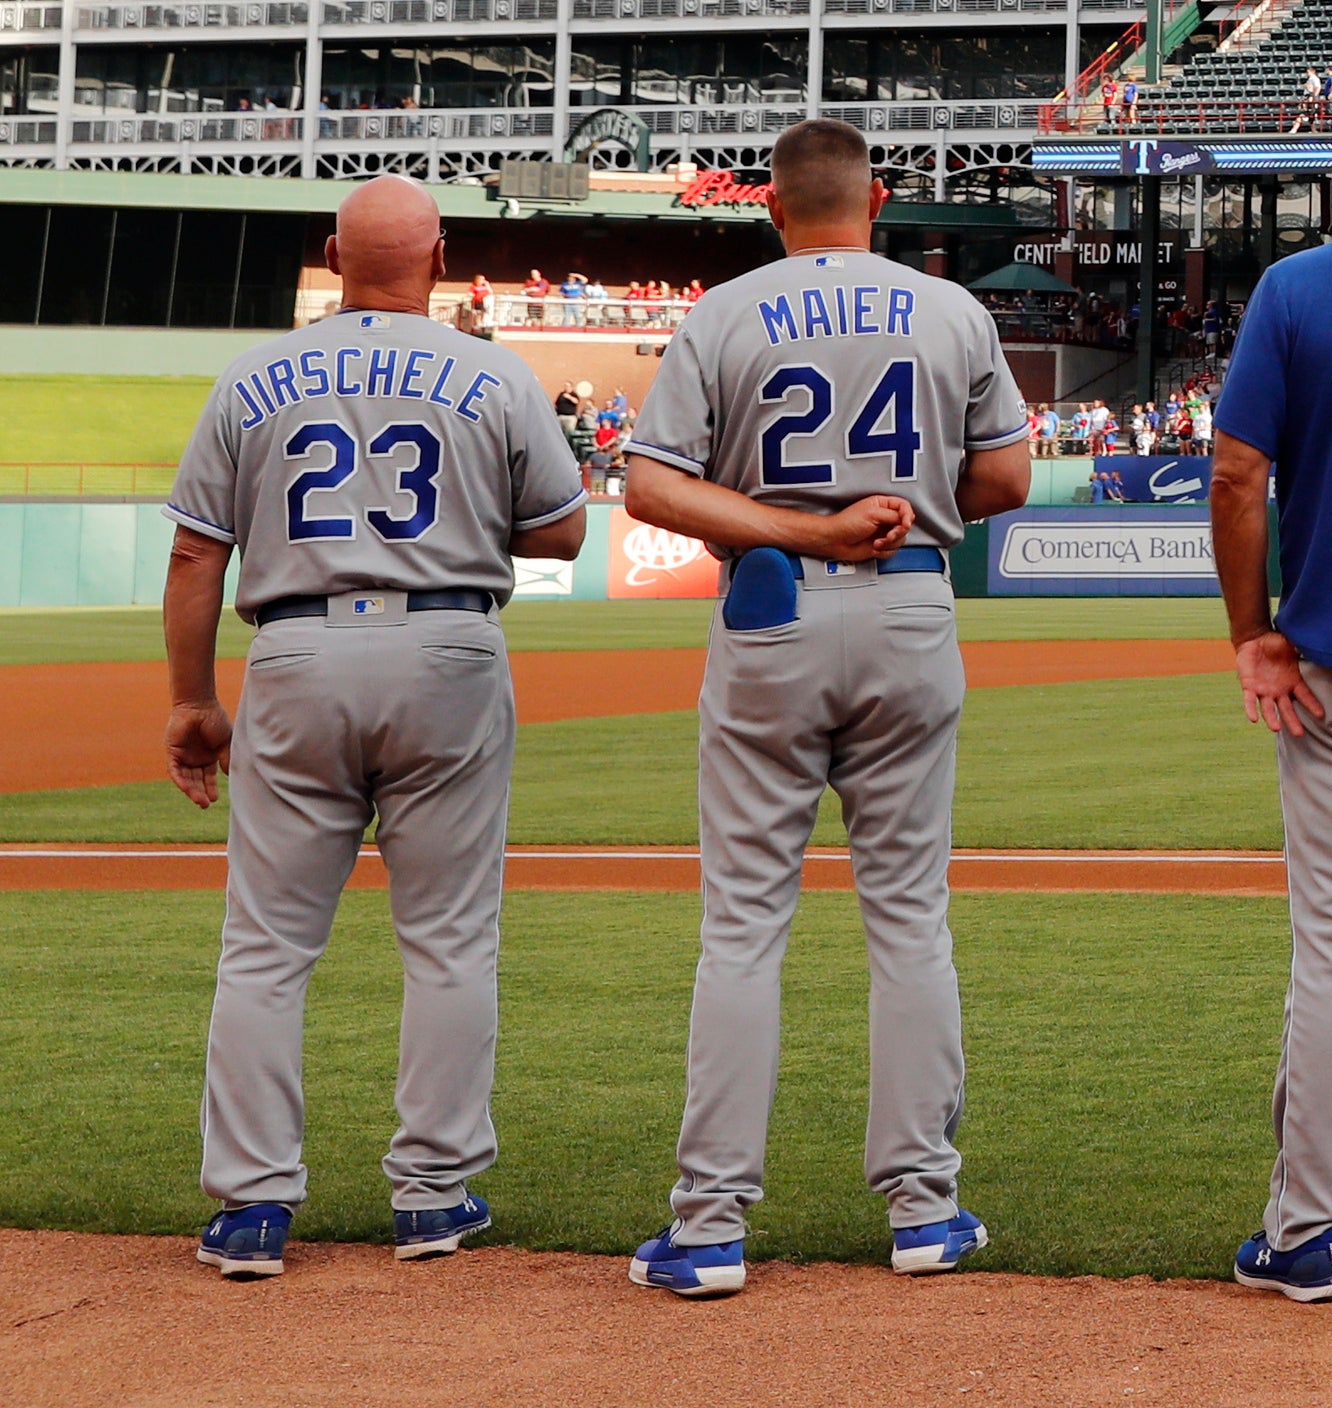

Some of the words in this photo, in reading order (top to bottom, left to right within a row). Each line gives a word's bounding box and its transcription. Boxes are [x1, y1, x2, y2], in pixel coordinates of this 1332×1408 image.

[1129, 139, 1158, 174] T
[1159, 151, 1202, 174] Rangers
[757, 284, 917, 348] MAIER
[1165, 281, 1178, 290] GO
[235, 346, 503, 432] JIRSCHELE
[758, 355, 923, 490] 24
[284, 420, 443, 545] 23
[1149, 536, 1213, 559] Bank
